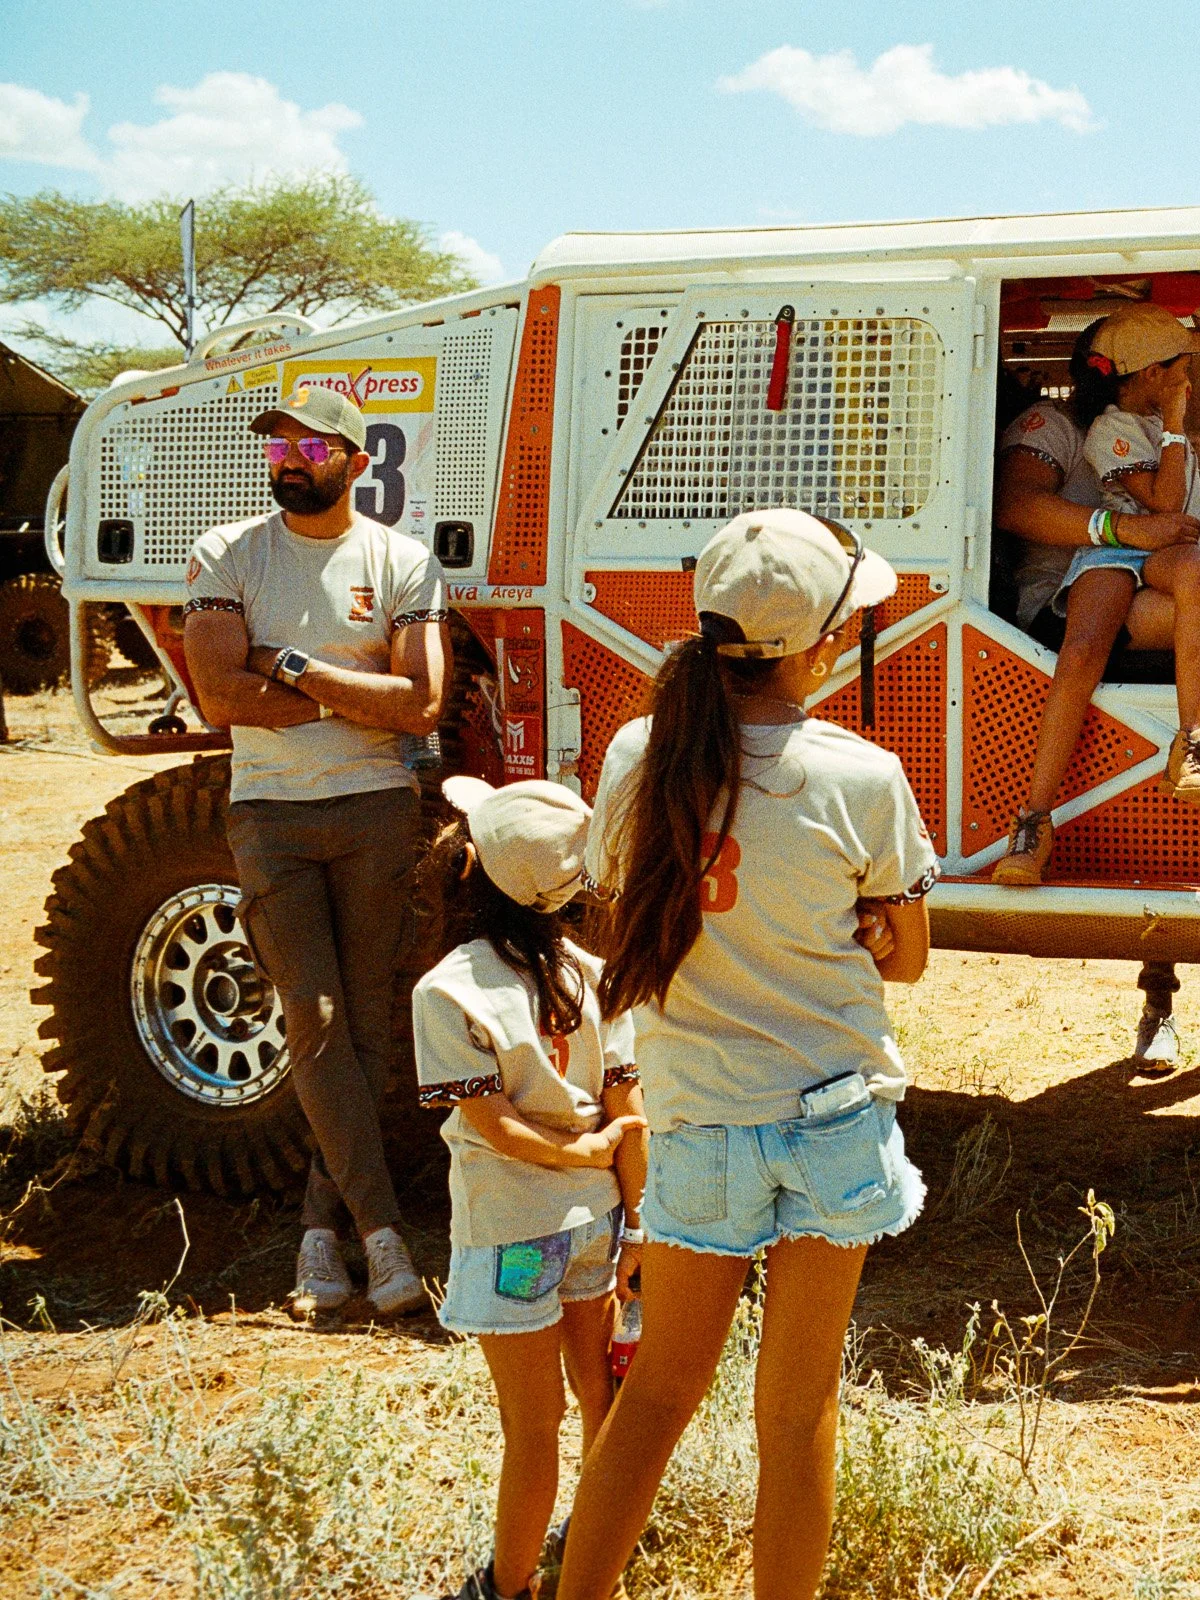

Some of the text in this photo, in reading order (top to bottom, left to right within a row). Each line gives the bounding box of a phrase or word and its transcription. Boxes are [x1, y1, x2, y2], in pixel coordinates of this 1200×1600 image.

[205, 343, 292, 371] Whatever it takes
[298, 366, 419, 409] atoXpress
[490, 586, 533, 602] Areya
